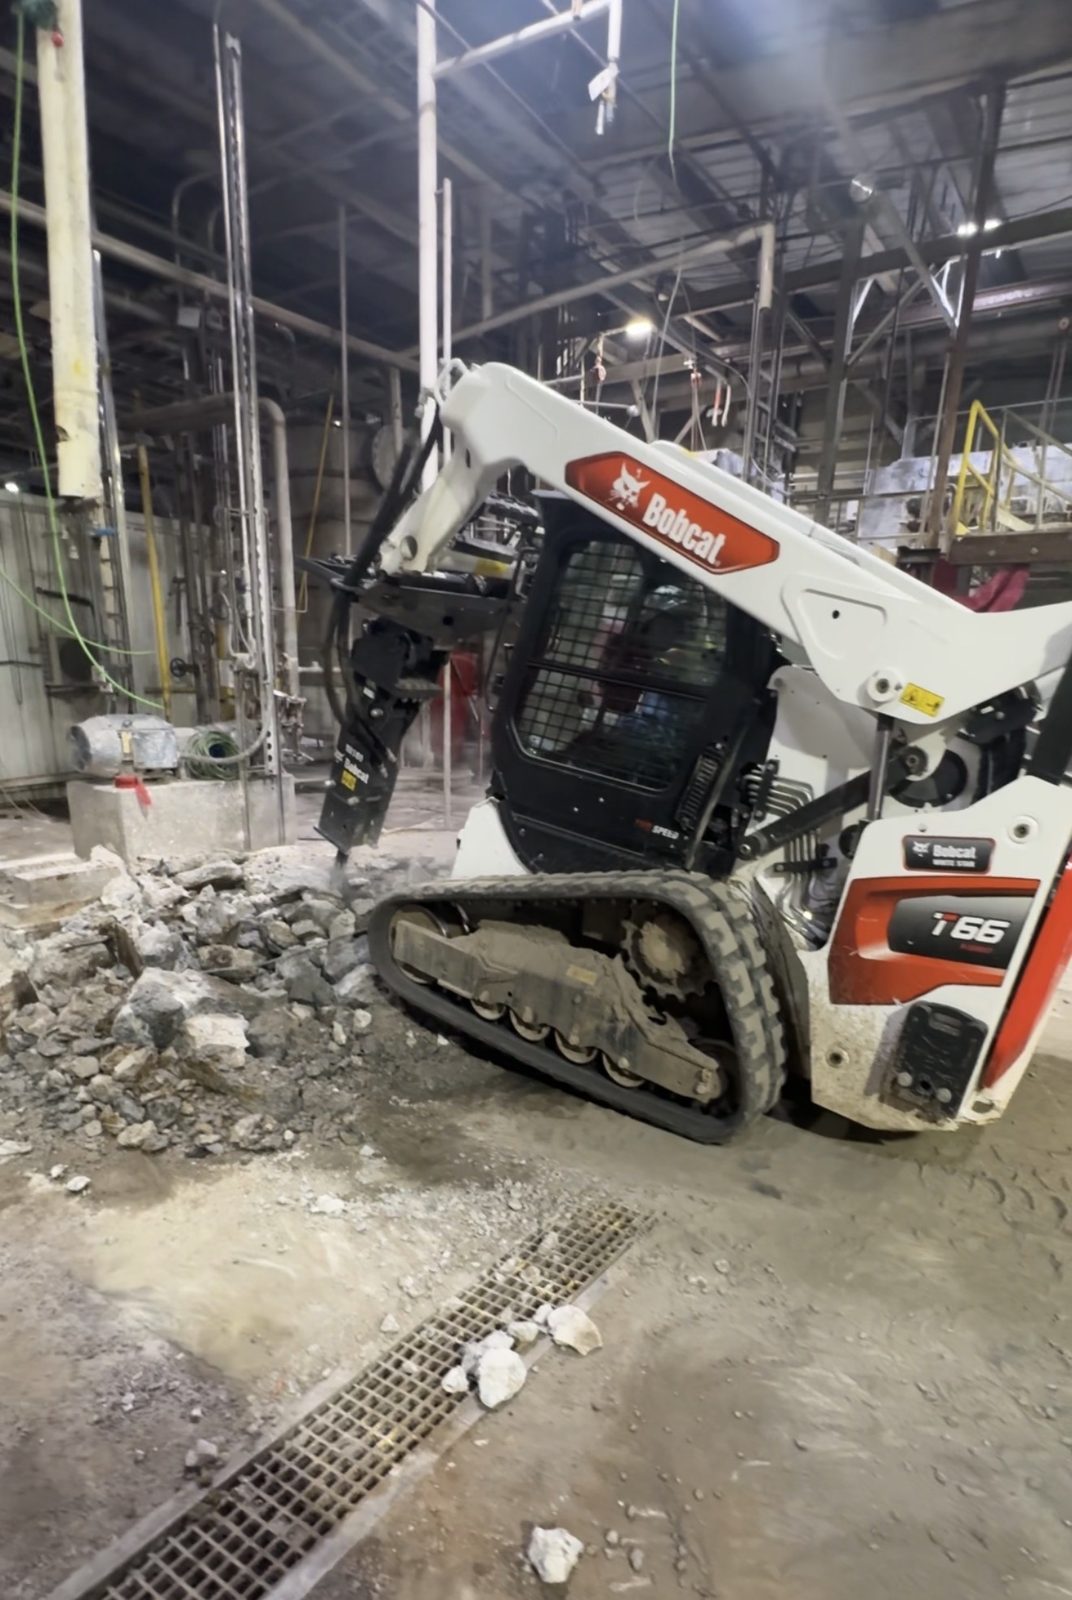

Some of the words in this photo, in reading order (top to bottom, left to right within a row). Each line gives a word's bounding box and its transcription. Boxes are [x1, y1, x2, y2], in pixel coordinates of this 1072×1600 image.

[642, 493, 726, 564] Bobcat
[933, 844, 976, 859] Bobcat
[932, 912, 1011, 944] T66
